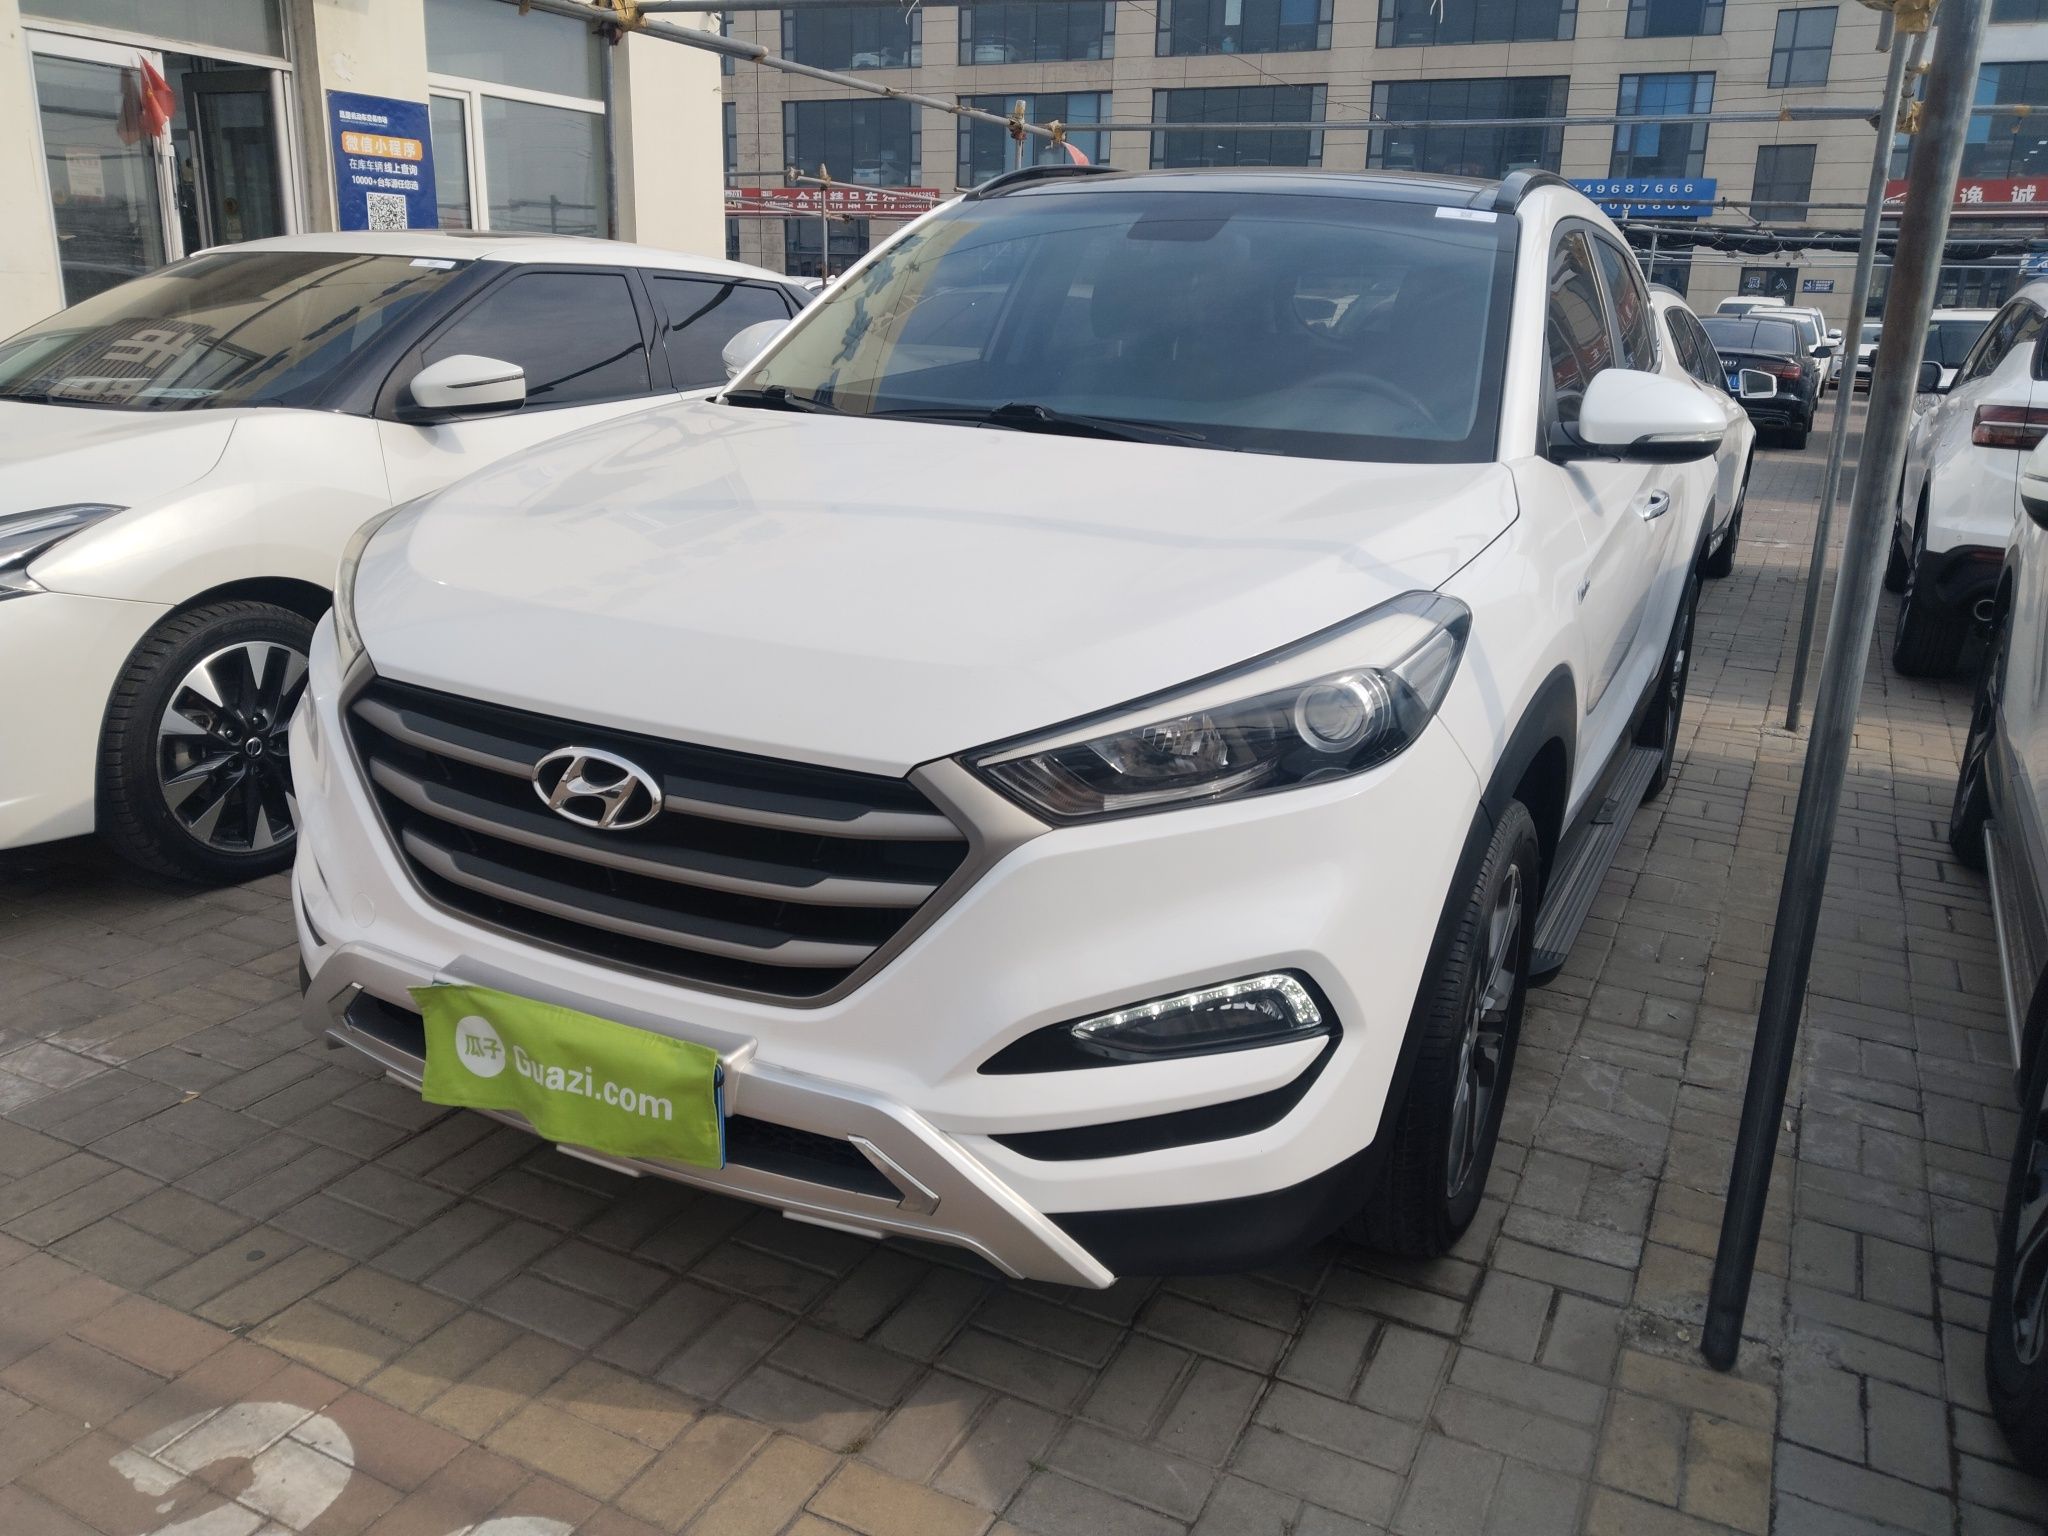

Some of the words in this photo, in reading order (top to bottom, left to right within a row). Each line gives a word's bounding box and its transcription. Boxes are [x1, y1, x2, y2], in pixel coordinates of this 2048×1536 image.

[345, 136, 416, 157] 微信小程序
[1576, 183, 1694, 194] 49687666
[464, 1034, 501, 1060] 瓜子
[512, 1045, 673, 1121] Guazi.com
